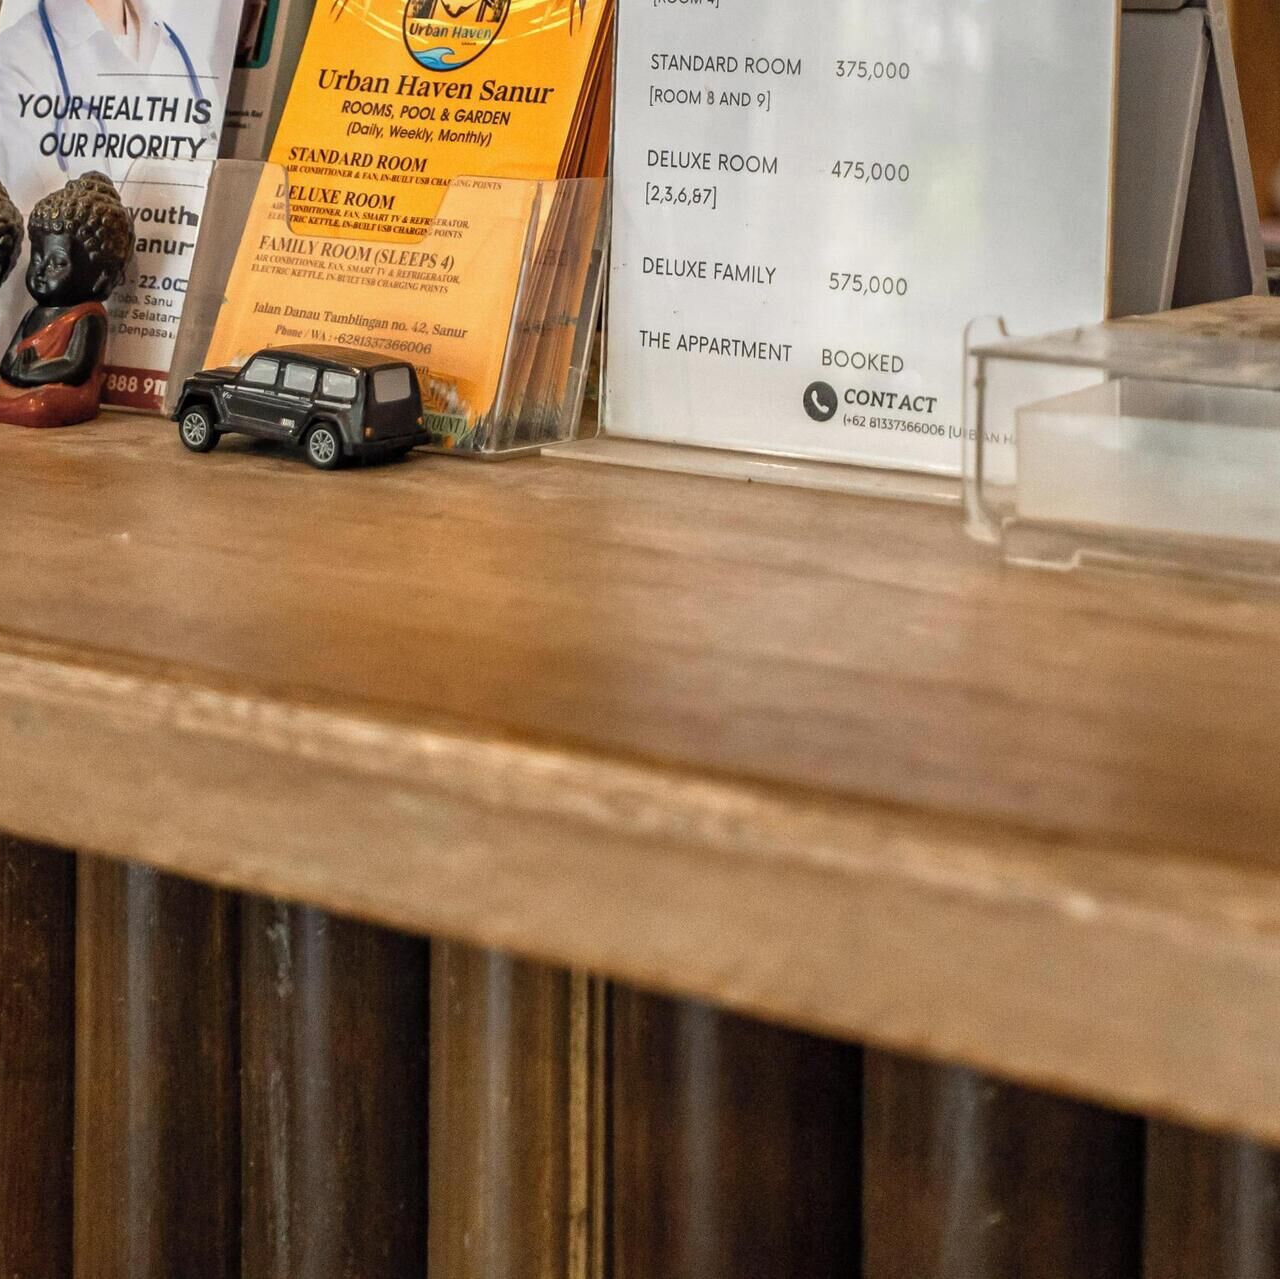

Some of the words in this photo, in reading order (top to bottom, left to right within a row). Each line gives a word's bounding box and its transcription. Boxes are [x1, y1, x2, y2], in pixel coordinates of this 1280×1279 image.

[409, 23, 448, 37] Urban
[452, 26, 491, 39] Haven
[651, 54, 738, 73] STANDARD
[745, 57, 802, 75] ROOM
[835, 60, 910, 80] 375,000
[319, 69, 390, 94] Urban
[395, 75, 472, 99] Haven
[480, 80, 554, 104] Sanur
[707, 91, 715, 105] 8
[719, 91, 751, 107] AND
[18, 94, 82, 119] YOUR
[87, 95, 178, 122] HEALTH
[185, 98, 212, 124] IS
[342, 100, 394, 119] ROOMS,
[400, 105, 435, 121] POOL
[440, 108, 450, 121] &
[454, 109, 511, 125] GARDEN
[40, 132, 88, 157] OUR
[92, 133, 207, 161] PRIORITY
[347, 122, 384, 139] (Daily,
[389, 125, 433, 143] Weekly,
[438, 129, 492, 147] Monthly)
[288, 146, 373, 168] STANDARD
[378, 156, 429, 173] ROOM
[299, 166, 353, 178] CONDITIONER
[648, 150, 711, 170] DELUXE
[718, 154, 778, 174] ROOM
[831, 161, 910, 183] 475,000
[275, 184, 342, 205] DELUXE
[344, 190, 396, 210] ROOM
[258, 235, 318, 255] FAMILY
[320, 242, 372, 262] ROOM
[374, 249, 439, 269] (SLEEPS
[440, 255, 455, 273] 4)
[642, 256, 707, 280] DELUXE
[714, 263, 777, 286] FAMILY
[829, 272, 908, 297] 575,000
[253, 302, 282, 315] Jalan
[283, 305, 321, 320] Danau
[324, 311, 389, 331] Tamblingan
[391, 320, 408, 332] no.
[432, 324, 468, 338] Sanur
[275, 323, 303, 338] Phone
[311, 328, 326, 342] WA
[639, 330, 671, 351] THE
[676, 334, 793, 362] APPARTMENT
[821, 348, 905, 374] BOOKED
[844, 389, 938, 414] CONTACT
[843, 414, 866, 428] (+62
[869, 416, 945, 437] 81337366006
